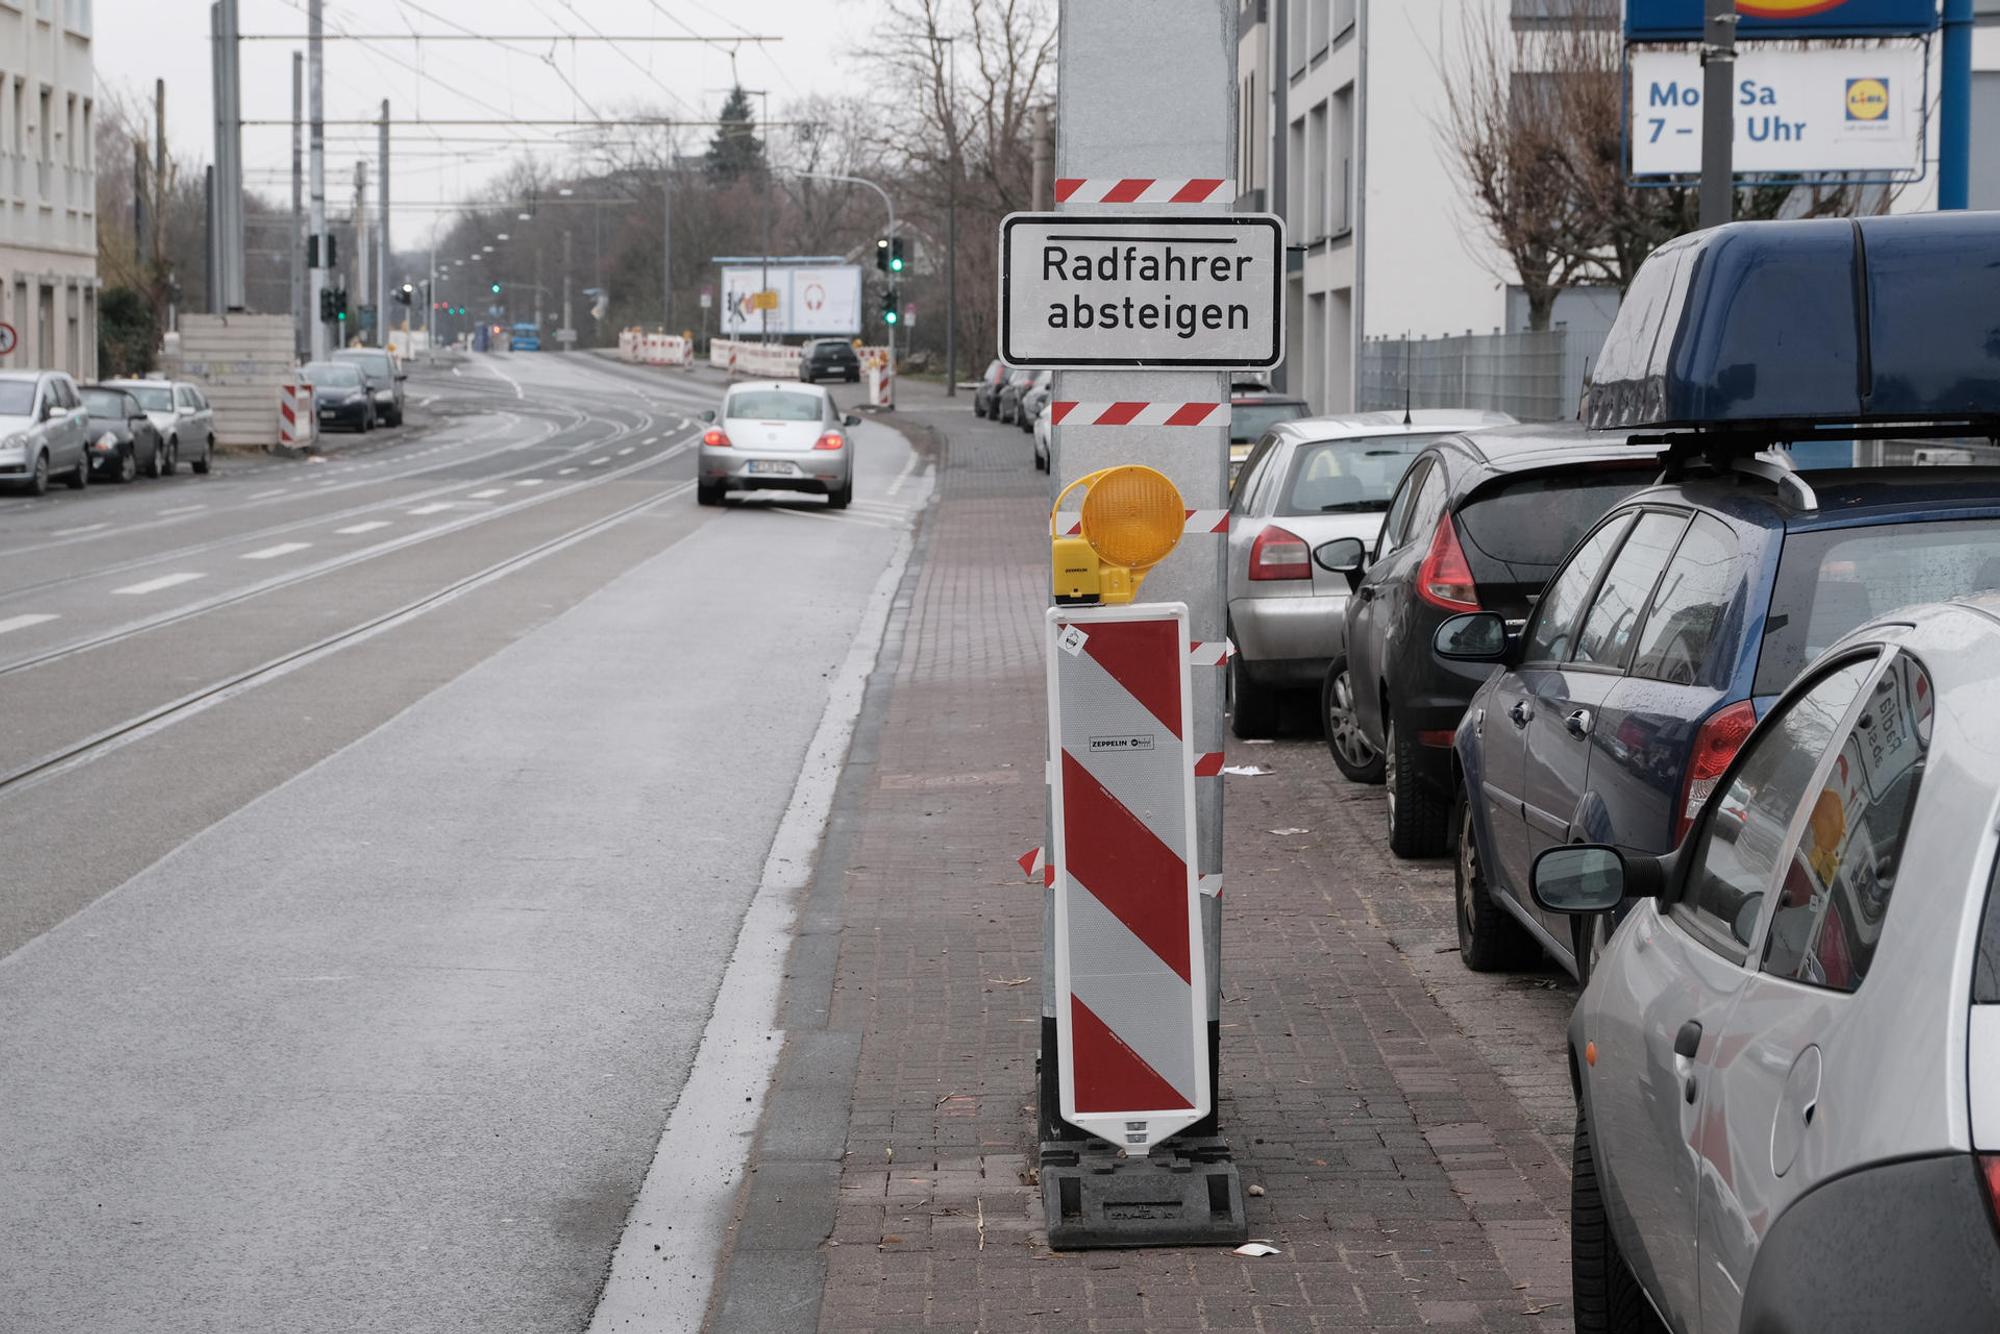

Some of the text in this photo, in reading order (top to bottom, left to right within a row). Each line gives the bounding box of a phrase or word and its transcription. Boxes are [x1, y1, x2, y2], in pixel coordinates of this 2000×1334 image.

[1649, 80, 1776, 107] Mo Sa
[1648, 118, 1666, 143] 7
[1748, 116, 1807, 142] Uhr
[1043, 246, 1253, 281] Radfahrer
[1048, 294, 1249, 339] absteigen
[1092, 740, 1128, 748] ZEPPELIN
